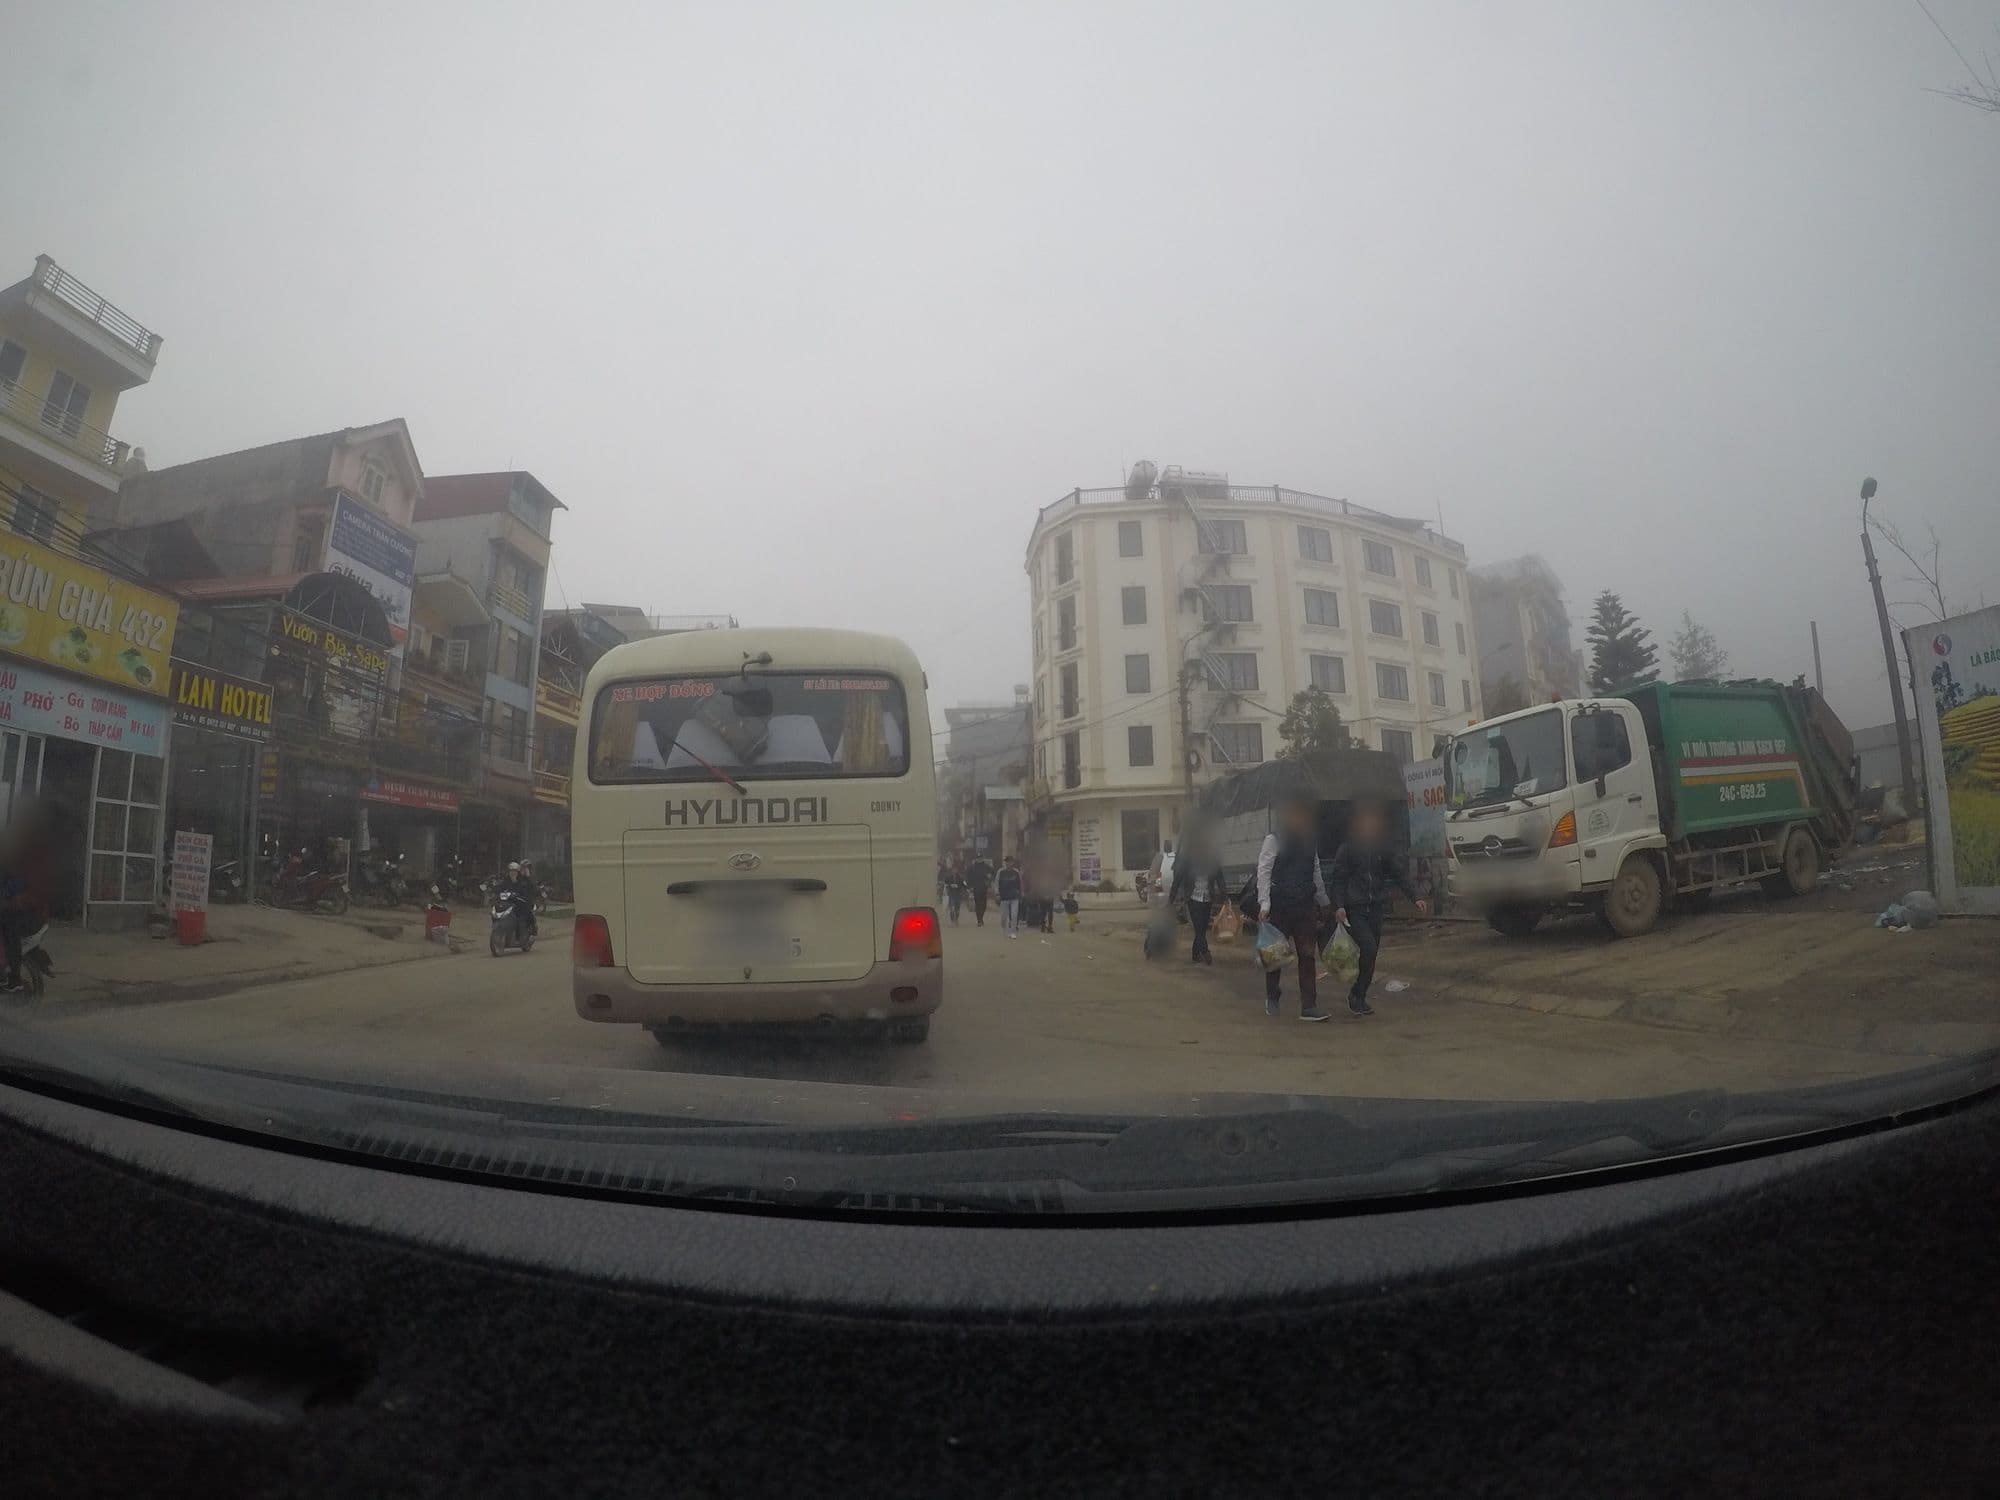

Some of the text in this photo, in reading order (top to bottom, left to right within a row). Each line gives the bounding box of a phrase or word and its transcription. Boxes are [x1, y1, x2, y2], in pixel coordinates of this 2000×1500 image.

[58, 576, 112, 635] CHẢ
[119, 602, 168, 653] 432
[23, 690, 55, 711] PHỞ
[177, 671, 273, 725] LAN HOTEL
[665, 797, 901, 826] HYUNDAI COUNTY
